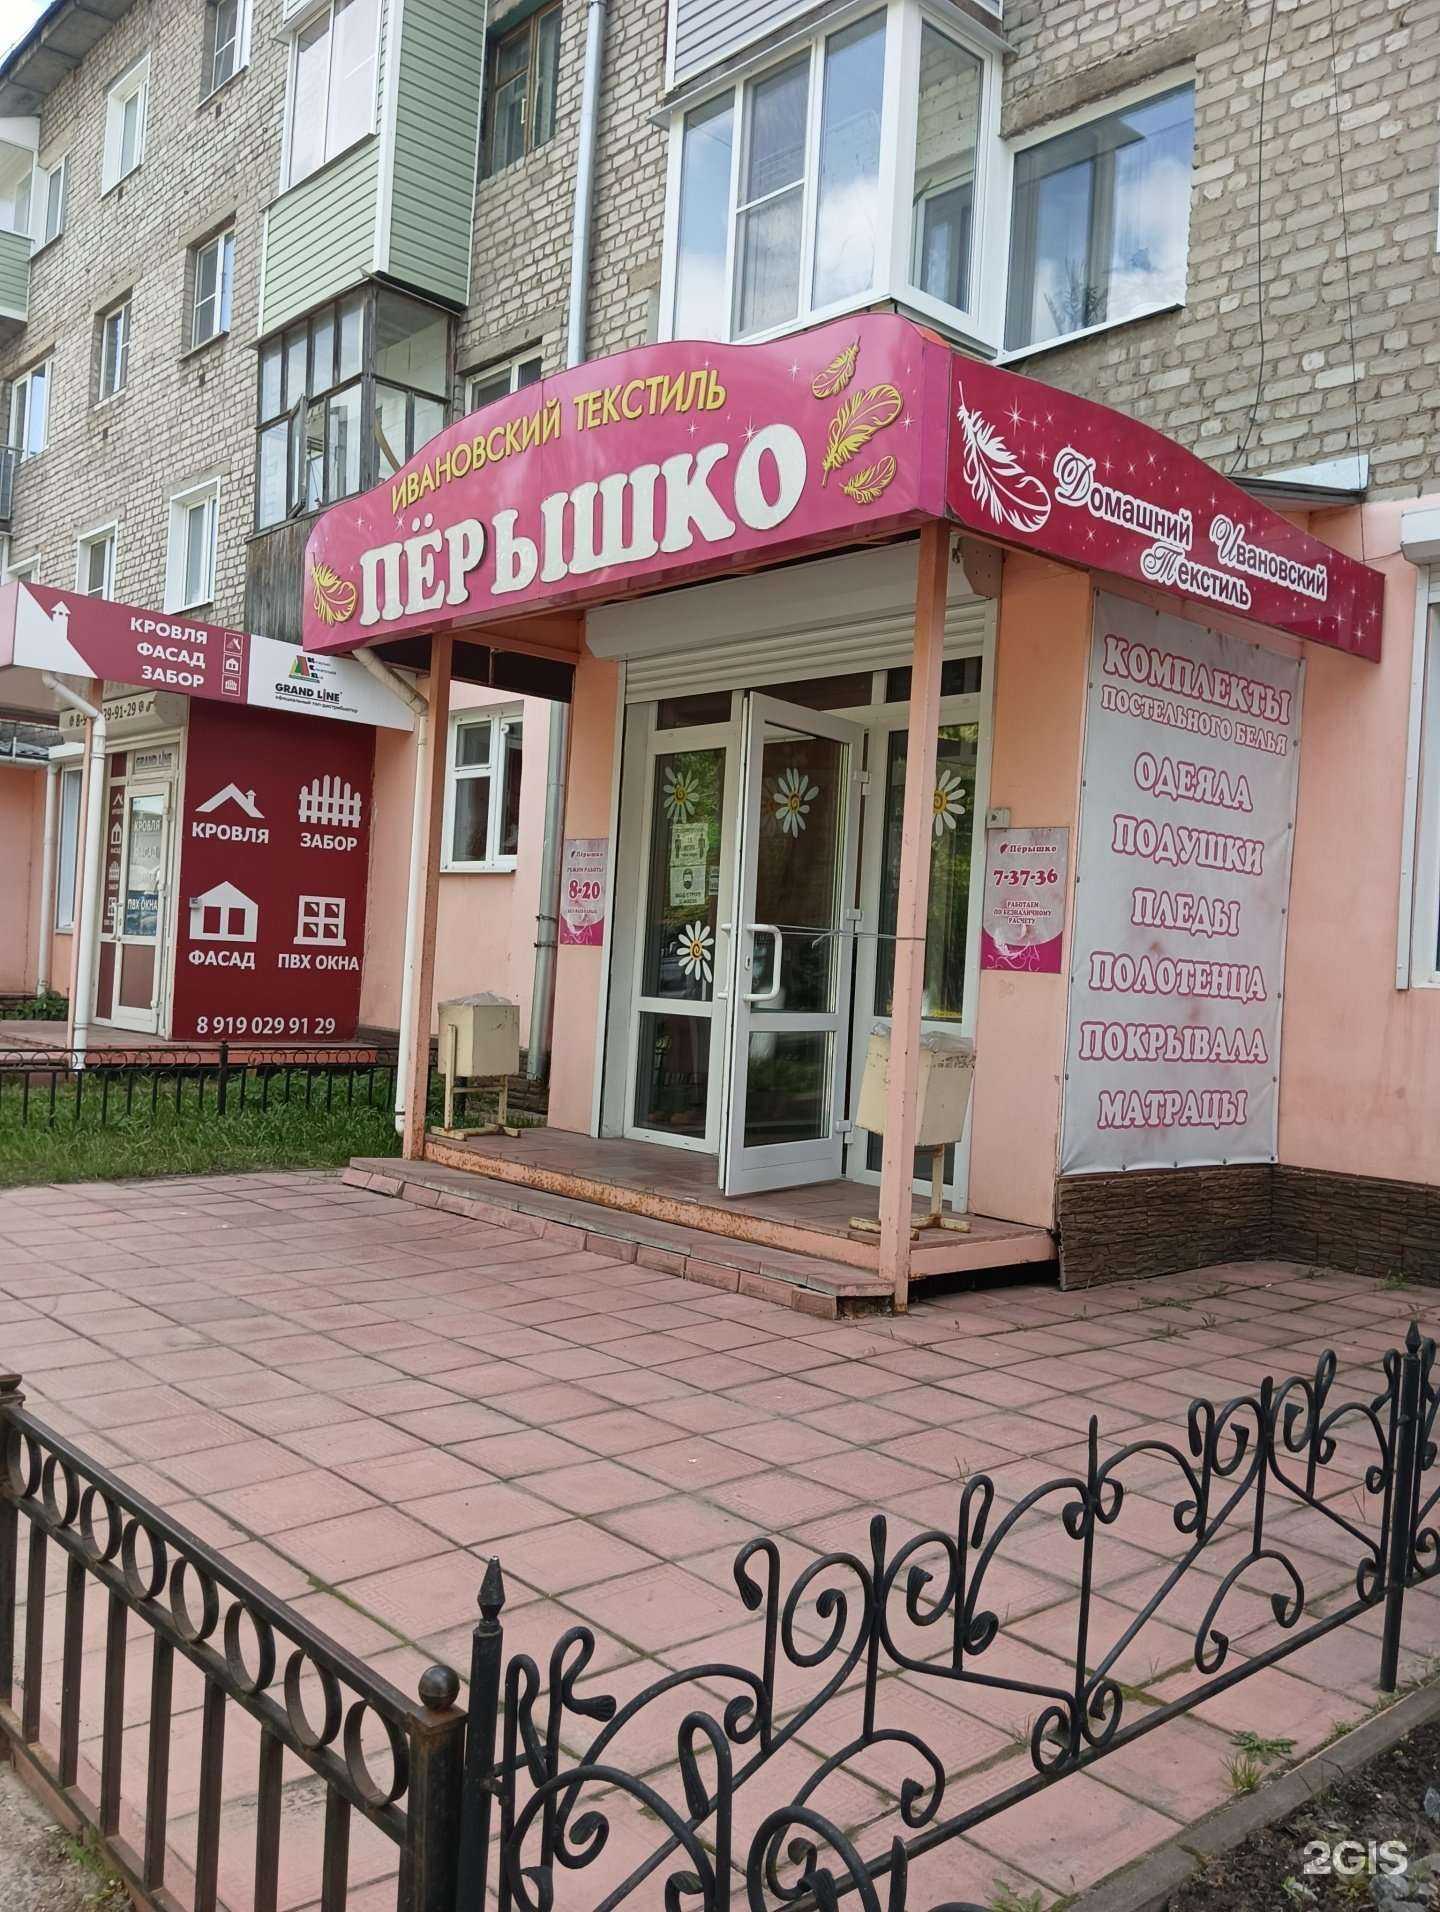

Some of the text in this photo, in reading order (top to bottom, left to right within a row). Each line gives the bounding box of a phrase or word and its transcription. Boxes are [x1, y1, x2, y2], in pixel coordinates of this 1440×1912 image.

[390, 369, 727, 514] ИВАНОВСКИЙ ТЕКСТИЛЬ
[1054, 447, 1193, 550] Домашний
[358, 424, 808, 627] ПЁРЫШКО
[1141, 543, 1251, 610] Текстиль
[1210, 514, 1328, 601] Ивановский
[130, 617, 208, 645] КРОВЛЯ
[136, 642, 206, 669] ФАСАД
[142, 665, 205, 687] ЗАБОР
[275, 683, 340, 702] GRAND LINE
[1103, 634, 1292, 725] КОМПЛЕКТЫ
[1101, 685, 1288, 756] ПОСТЕЛЬНОГО БЕЛЬЯ
[1133, 752, 1254, 812] ОДЕЯЛА
[192, 822, 270, 844] КРОВЛЯ
[300, 832, 358, 852] ЗАБОР
[1111, 814, 1264, 876] ПОДУШКИ
[568, 879, 601, 900] 8-20
[993, 868, 1058, 886] 7-37-36
[1003, 909, 1052, 917] БЕЗНАЛИЧНОМУ
[1131, 887, 1241, 938] ПЛЕДЫ
[188, 950, 256, 970] ФАСАД
[278, 953, 360, 971] ПВХ ОКНА
[1088, 951, 1267, 1003] ПОЛОТЕНЦА
[196, 1016, 336, 1035] 8 919 029 91 29
[1079, 1020, 1269, 1064] ПОКРЫВАЛА
[1098, 1090, 1249, 1129] МАТРАЦЫ
